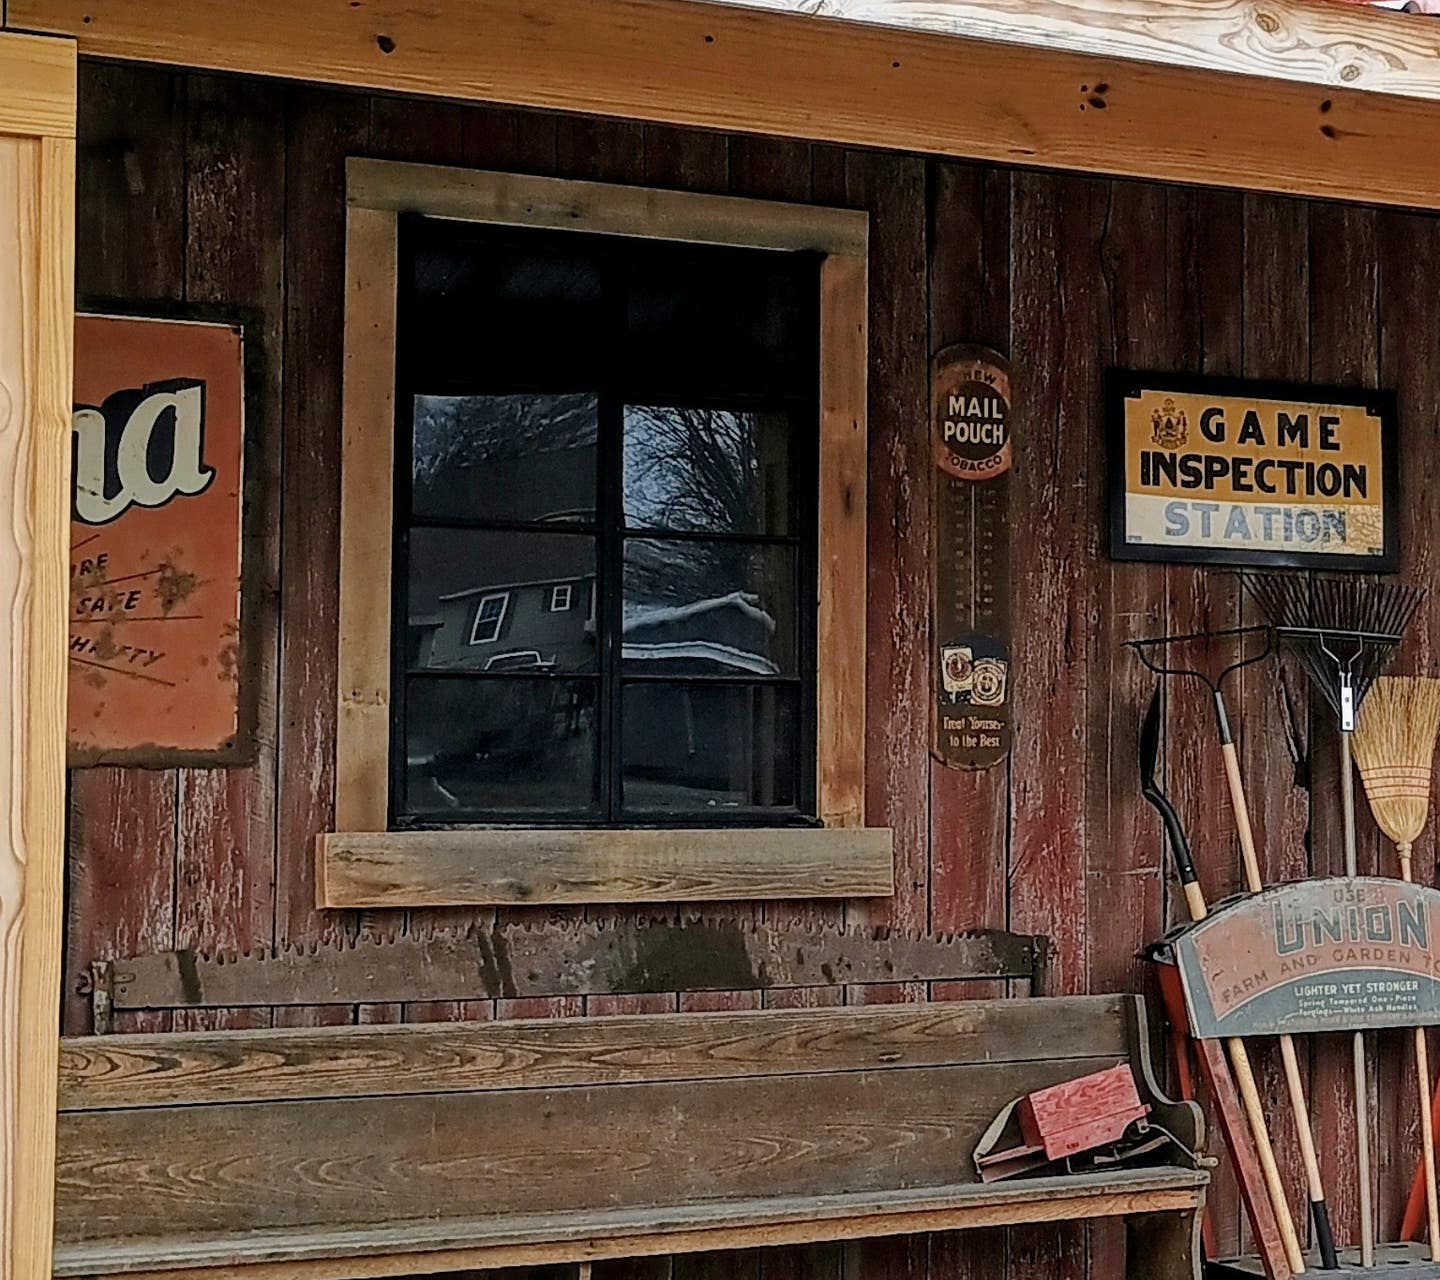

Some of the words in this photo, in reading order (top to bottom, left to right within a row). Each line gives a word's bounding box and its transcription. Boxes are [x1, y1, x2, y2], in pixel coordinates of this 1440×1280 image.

[948, 395, 1004, 419] MAIL
[1200, 407, 1340, 451] GAME
[944, 421, 1004, 444] POUCH
[946, 454, 1003, 472] OBACCO
[1139, 450, 1368, 500] INSPECTION
[1164, 501, 1348, 545] STATION
[1274, 898, 1430, 956] UNION
[1221, 969, 1269, 1003] FARM
[1280, 954, 1318, 975] AND
[1332, 947, 1412, 964] GARDEN
[1295, 984, 1337, 997] LIGHTER
[1341, 982, 1363, 995] YET
[1366, 980, 1419, 994] STRONGER
